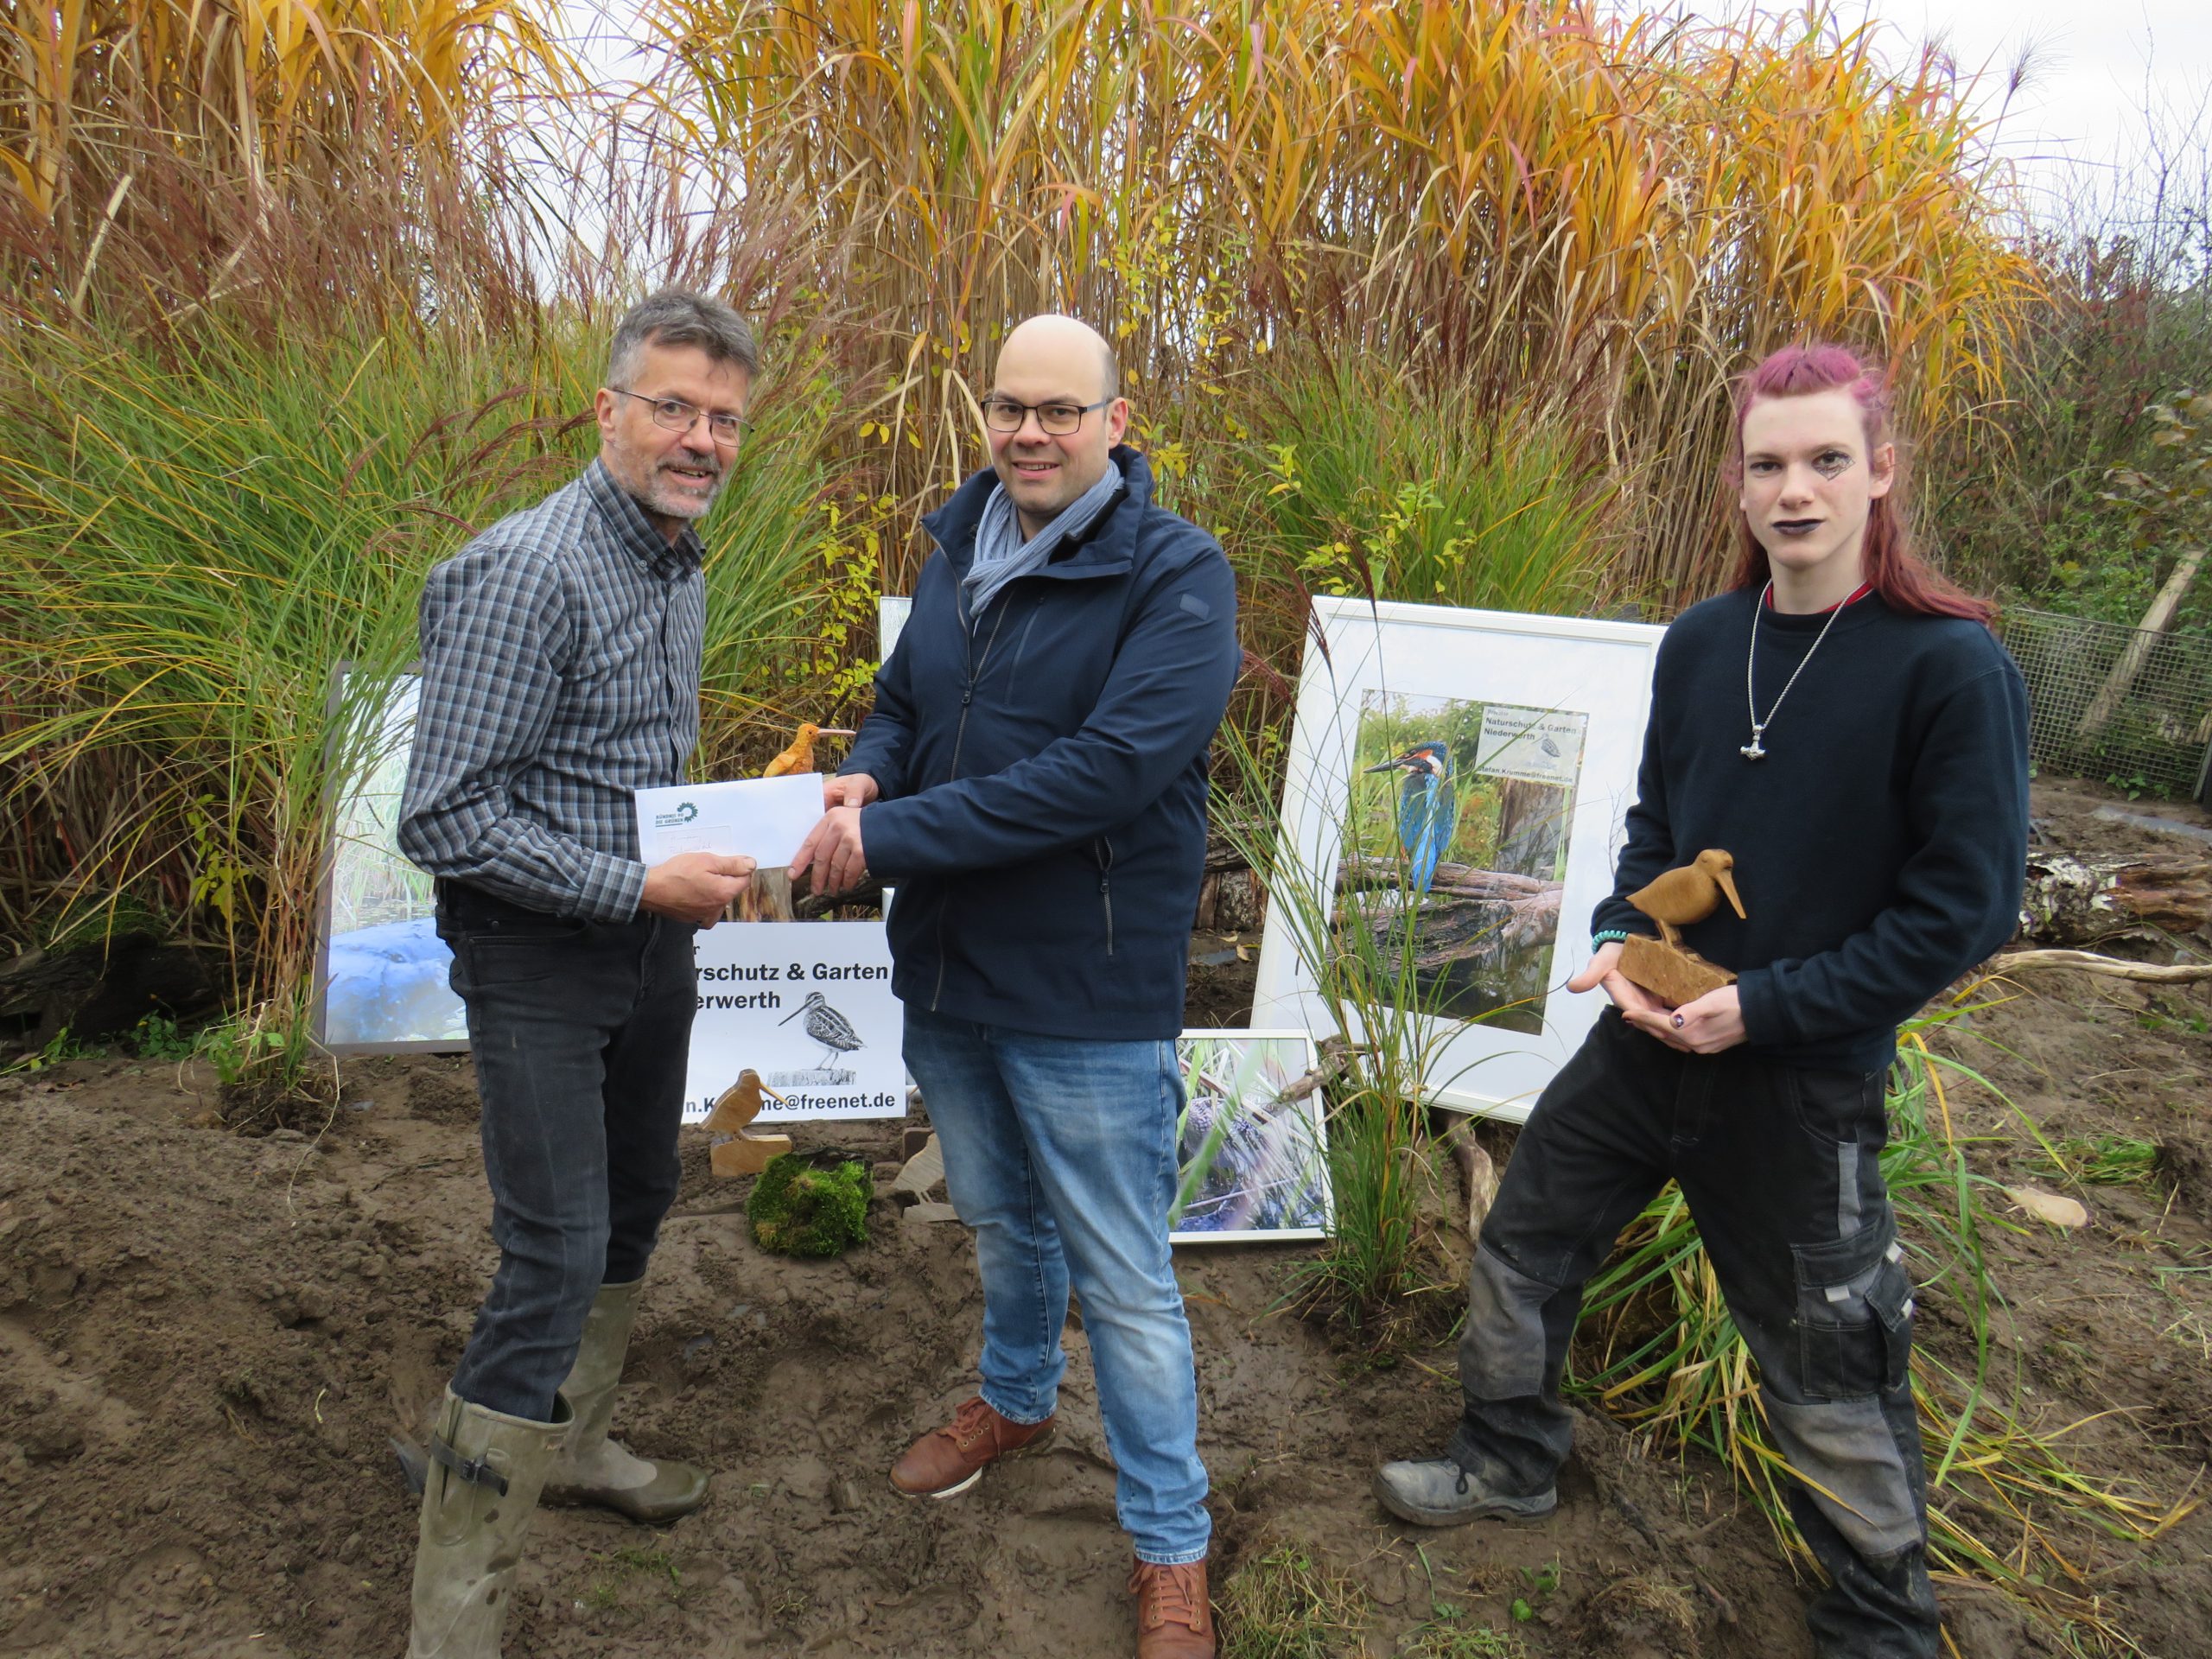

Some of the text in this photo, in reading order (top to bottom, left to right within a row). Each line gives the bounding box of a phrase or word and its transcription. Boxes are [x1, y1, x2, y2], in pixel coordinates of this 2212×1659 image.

[1548, 724, 1577, 734] Garten
[695, 963, 888, 981] rschutz & Garten
[697, 991, 781, 1009] erwerth
